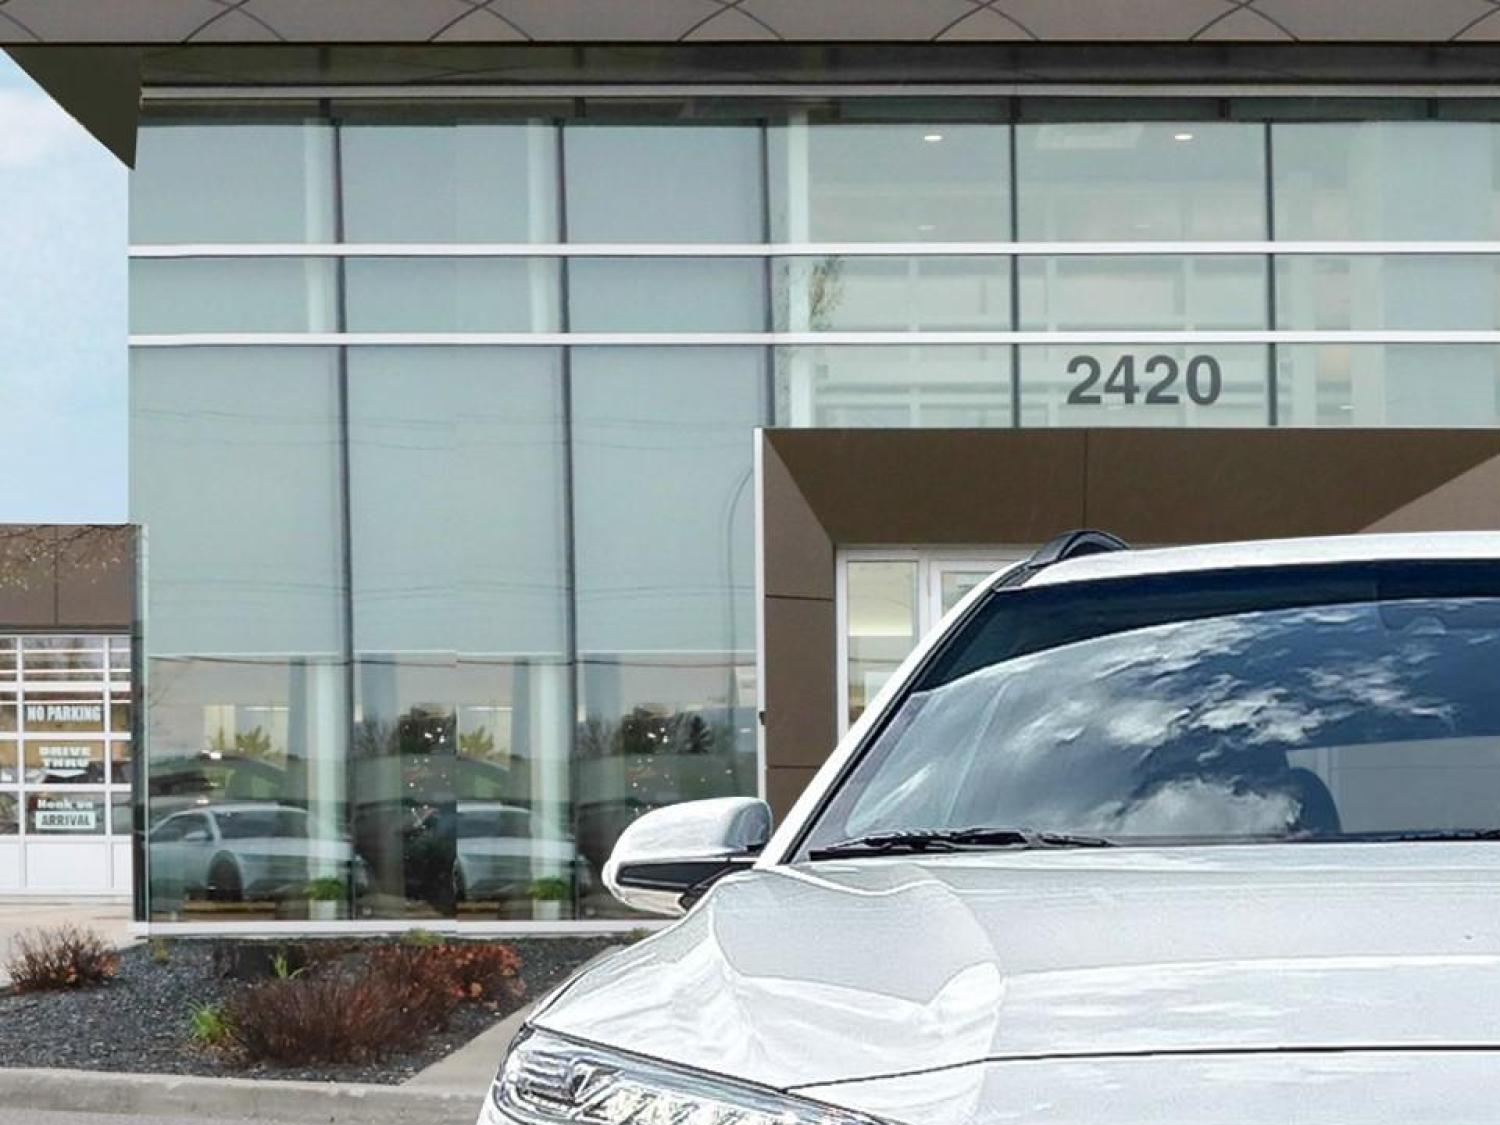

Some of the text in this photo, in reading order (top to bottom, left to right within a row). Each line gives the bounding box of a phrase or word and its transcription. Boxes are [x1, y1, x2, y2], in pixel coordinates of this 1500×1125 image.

[1066, 355, 1222, 406] 2420
[27, 705, 101, 721] NO PARKING
[41, 814, 91, 826] ARRIVAL
